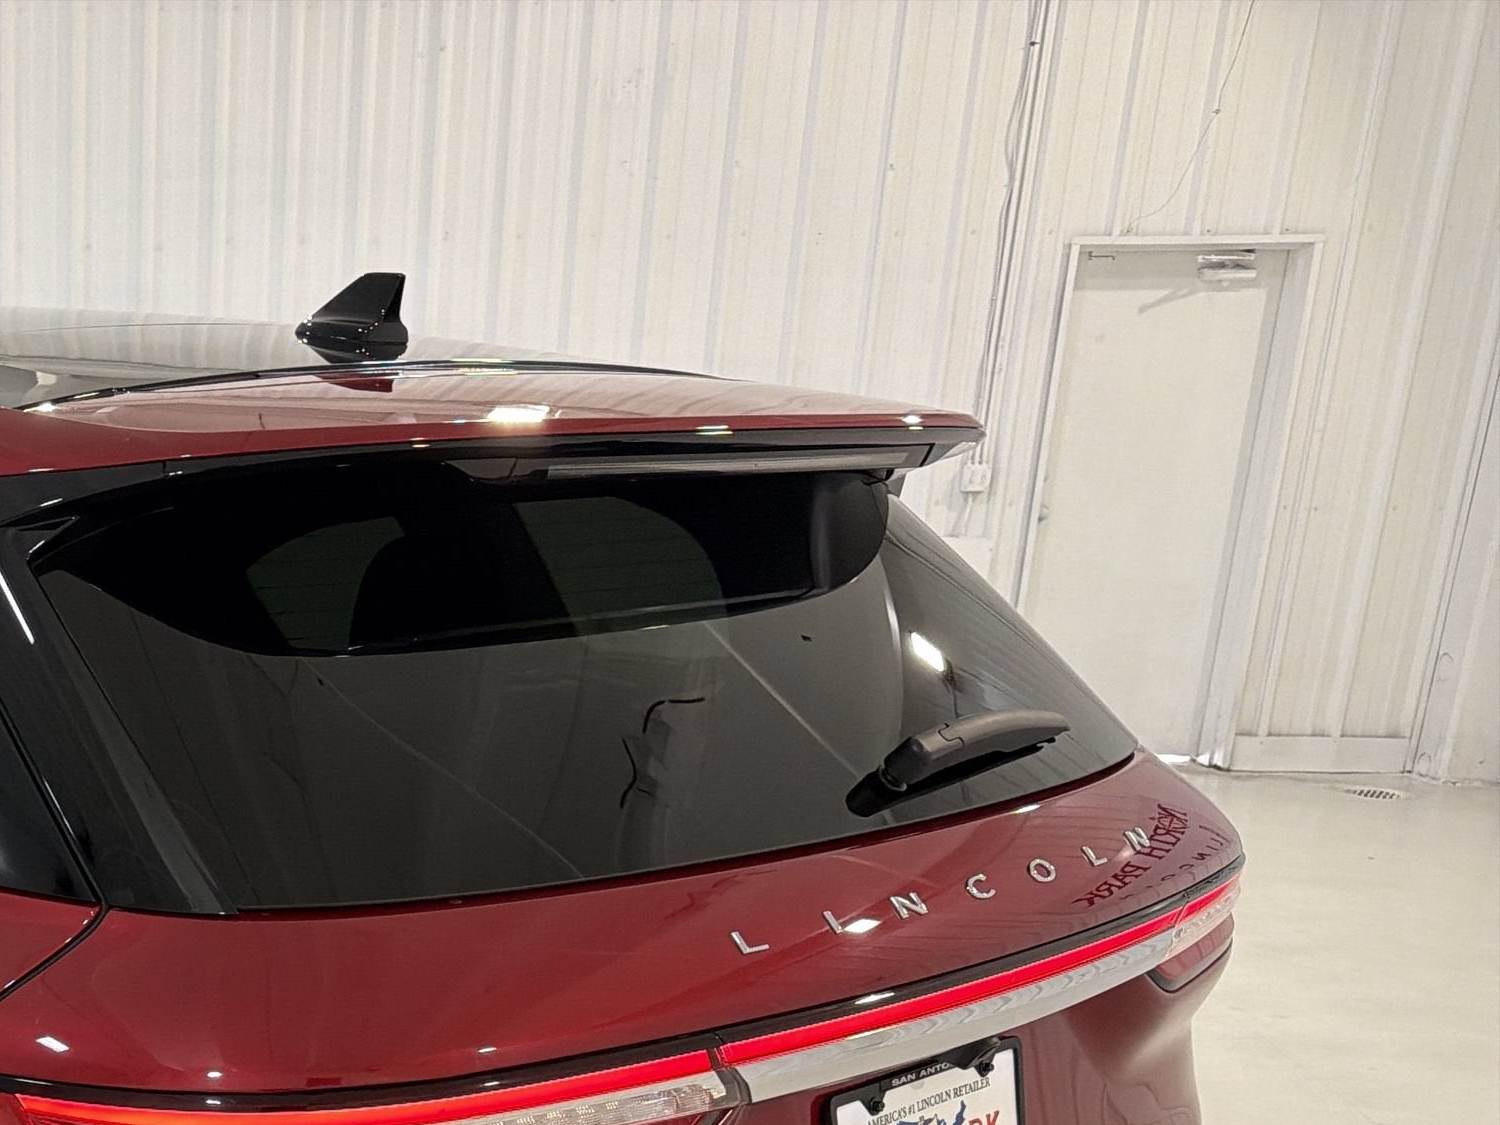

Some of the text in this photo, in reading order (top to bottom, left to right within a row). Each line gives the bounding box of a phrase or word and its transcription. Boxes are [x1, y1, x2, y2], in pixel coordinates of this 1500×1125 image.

[731, 826, 1151, 955] LINCOLN
[892, 1062, 954, 1087] SAN ANTO
[908, 1104, 916, 1116] #1
[916, 1089, 952, 1112] LINCOLN
[953, 1077, 991, 1099] RETAILER
